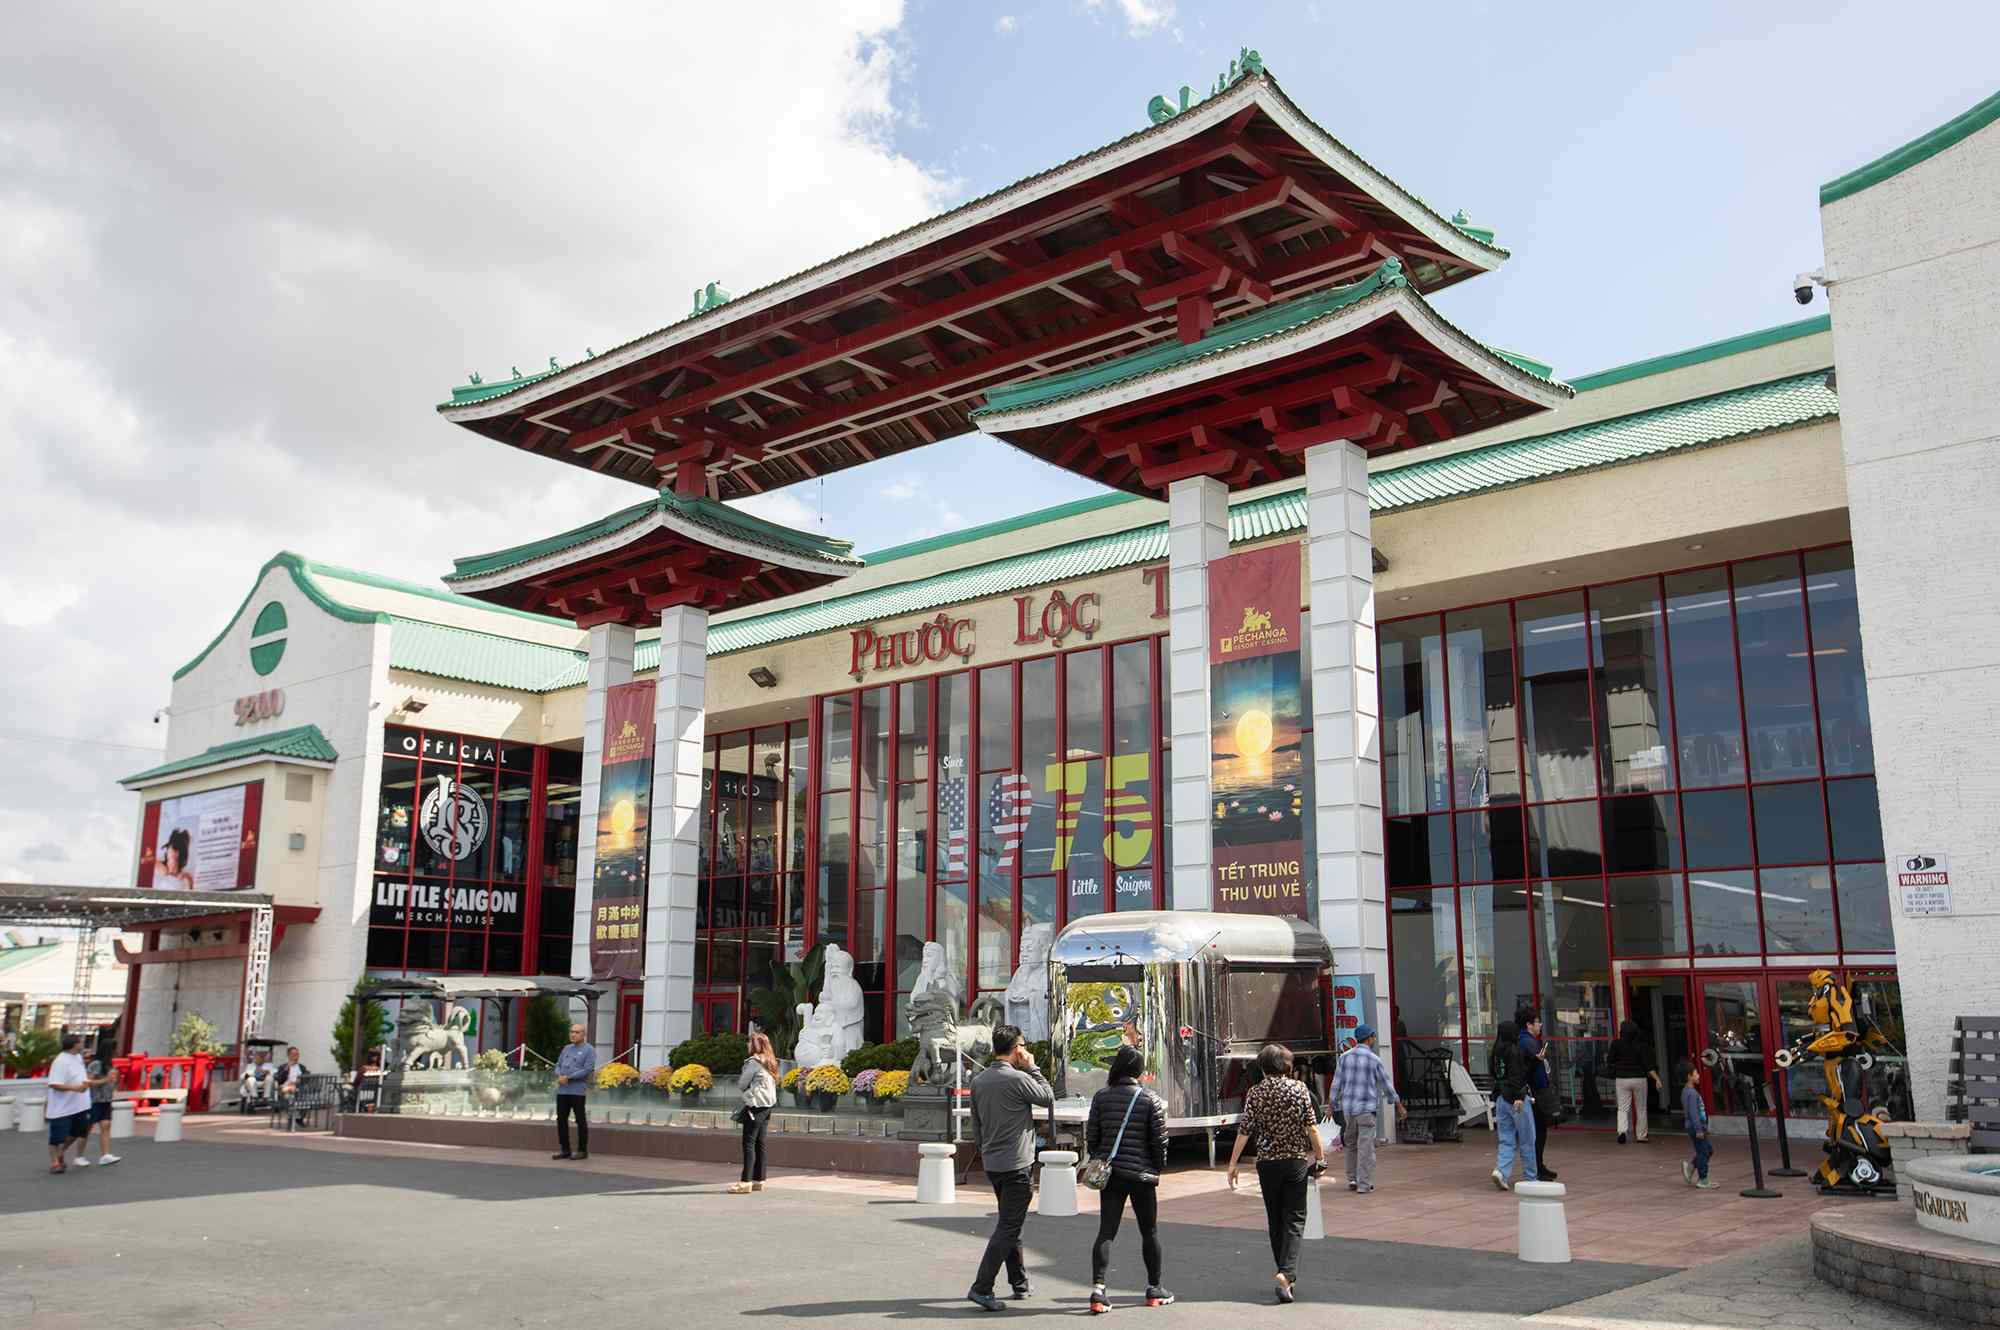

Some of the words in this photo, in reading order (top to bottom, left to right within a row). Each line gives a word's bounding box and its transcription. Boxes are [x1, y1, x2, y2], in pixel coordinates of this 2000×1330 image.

[1233, 627, 1287, 644] PECHANGA
[403, 737, 507, 764] OFFICIAL
[942, 755, 963, 769] Since
[940, 752, 1153, 877] 1975
[1218, 861, 1245, 881] TẾT
[1249, 861, 1299, 879] TRUNG
[1900, 873, 1946, 885] WARNING
[1071, 877, 1099, 896] Little
[1115, 876, 1152, 896] Saigon
[1220, 887, 1249, 901] THU
[1253, 883, 1277, 899] VUI
[377, 882, 440, 910] LITTLE
[443, 886, 517, 913] SAIGON
[395, 912, 494, 925] MERCHANDISE
